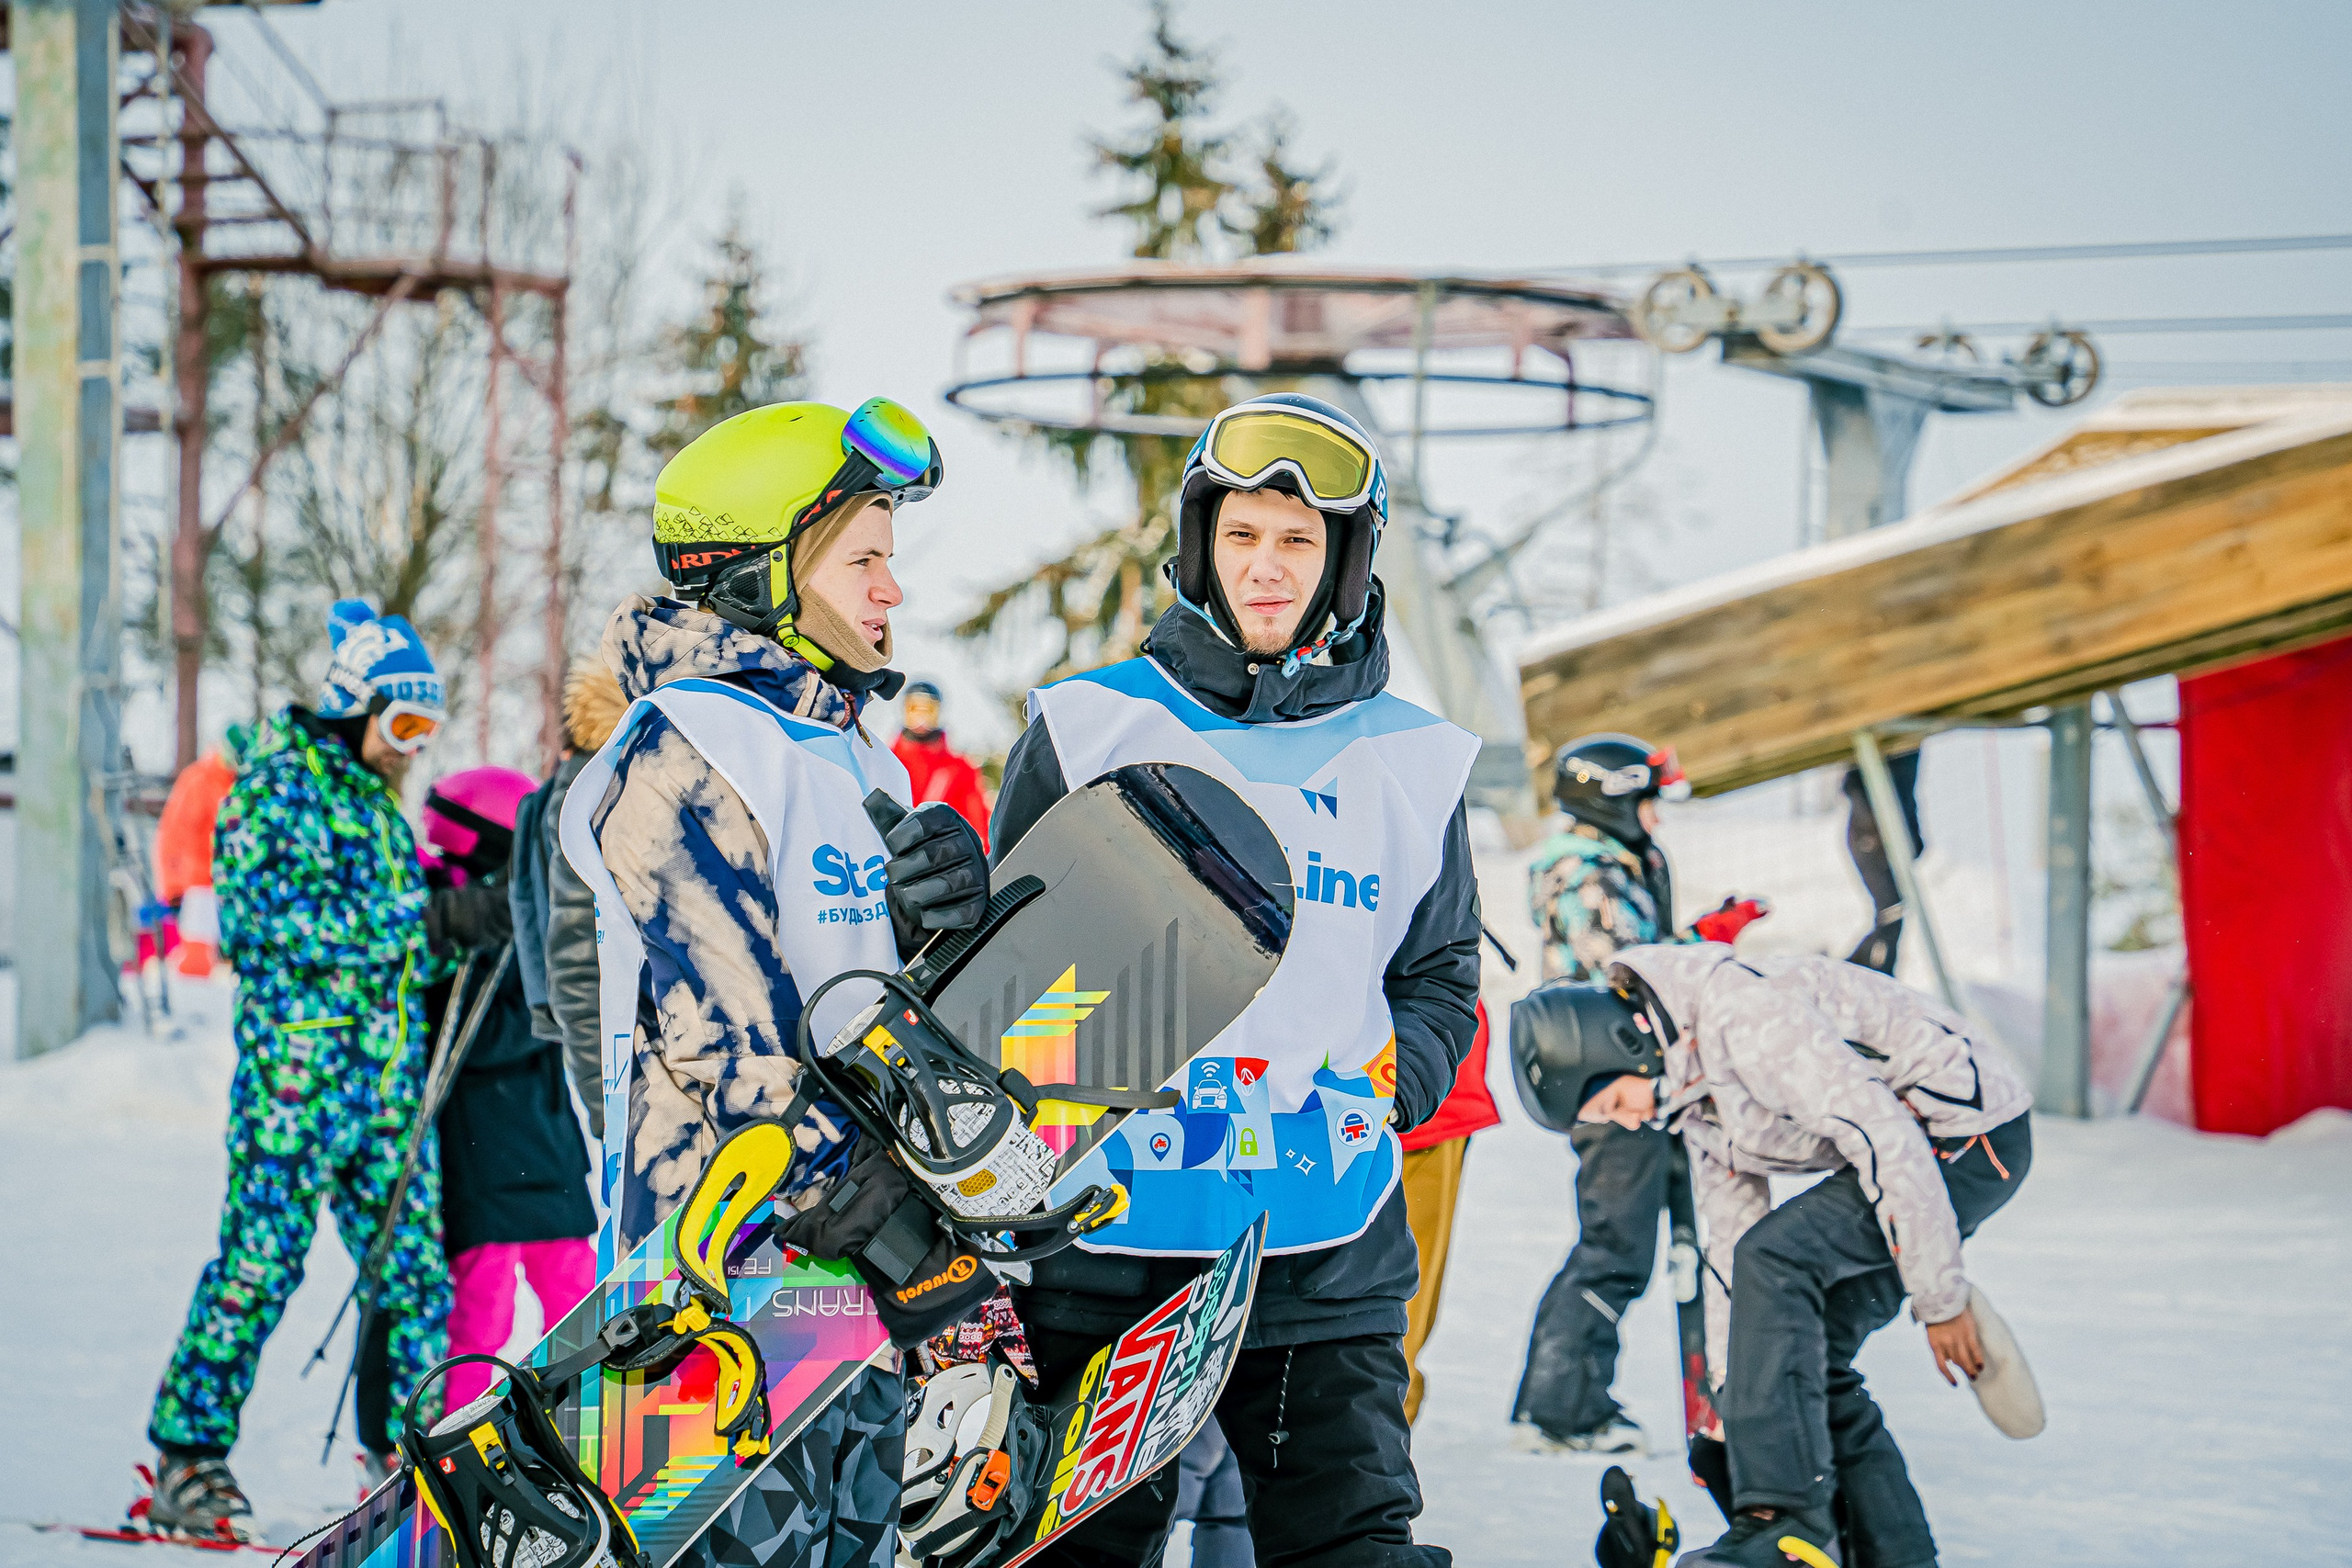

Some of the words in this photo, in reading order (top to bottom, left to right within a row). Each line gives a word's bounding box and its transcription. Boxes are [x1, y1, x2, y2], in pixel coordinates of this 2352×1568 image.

[1284, 846, 1380, 912] ine
[742, 1257, 772, 1276] FE
[1062, 1282, 1194, 1515] VANS
